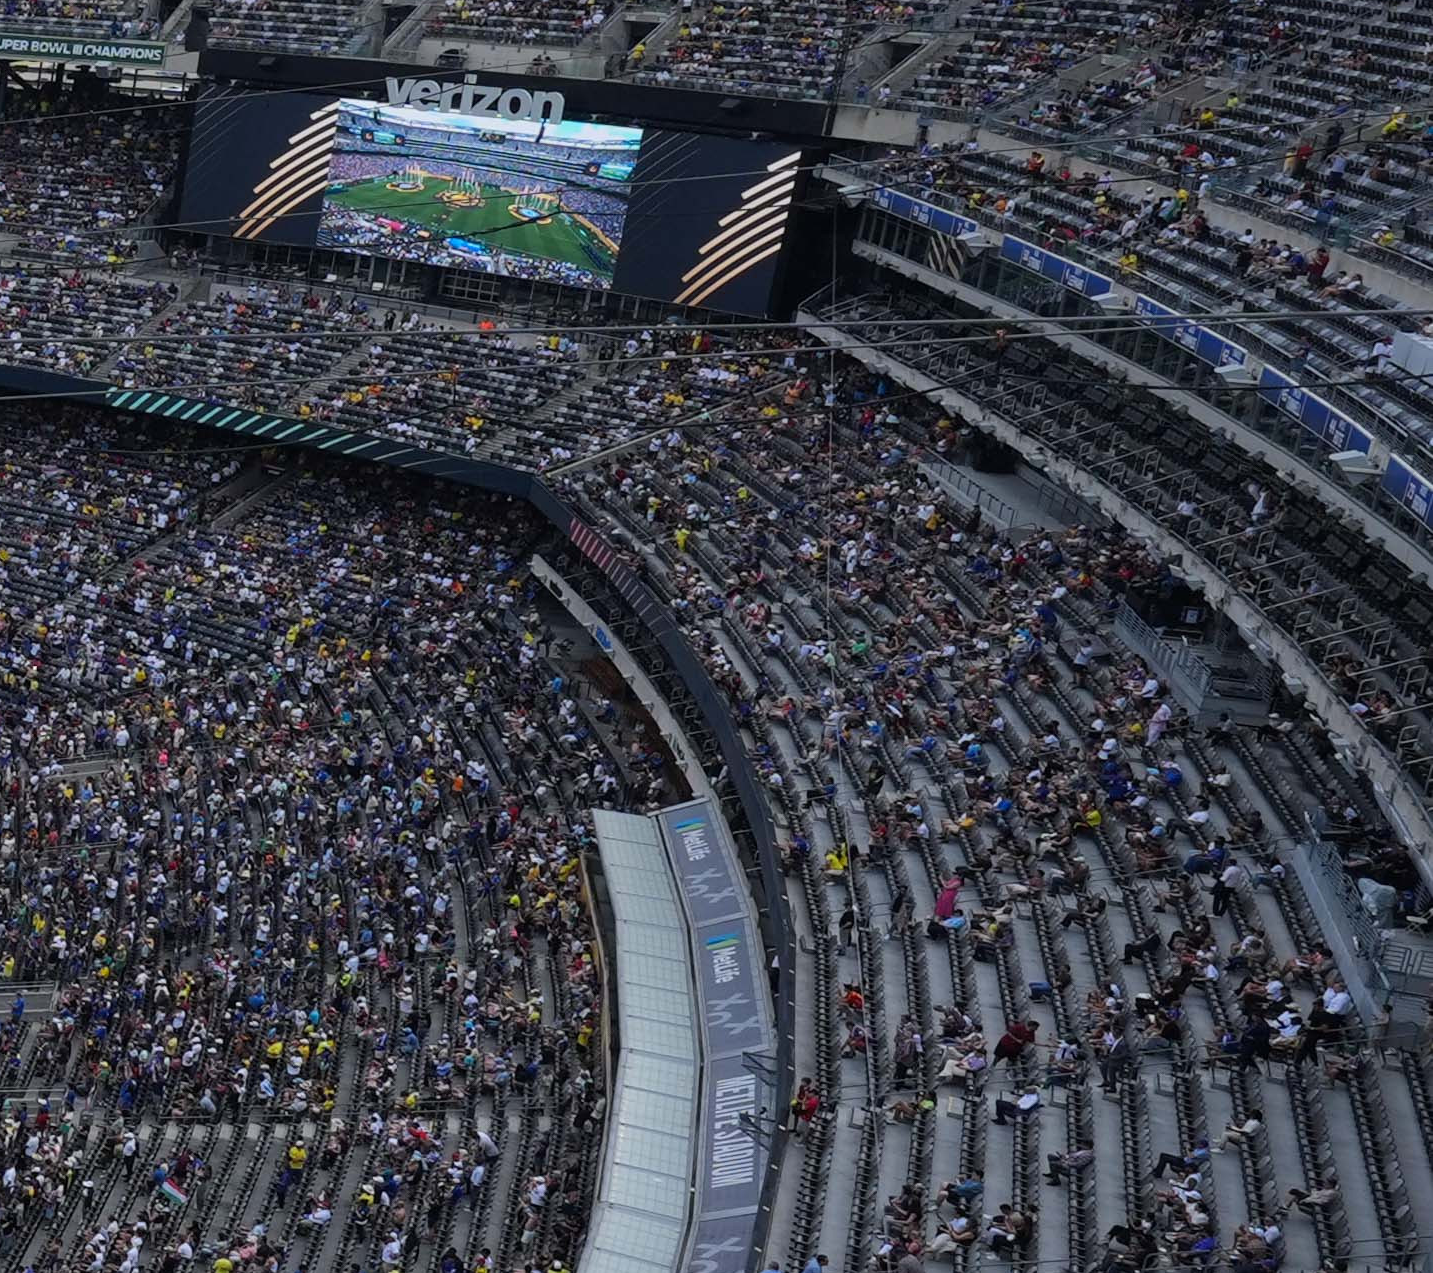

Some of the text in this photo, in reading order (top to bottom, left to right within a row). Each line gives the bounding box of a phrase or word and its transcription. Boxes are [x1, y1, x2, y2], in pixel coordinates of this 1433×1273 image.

[31, 40, 70, 54] BOWL
[72, 44, 82, 55] III
[84, 45, 162, 61] CHAMPIONS
[385, 73, 565, 125] verizon
[682, 828, 710, 862] MetLife
[712, 946, 740, 984] MetLife
[711, 1074, 756, 1188] METLIFE STADIUM
